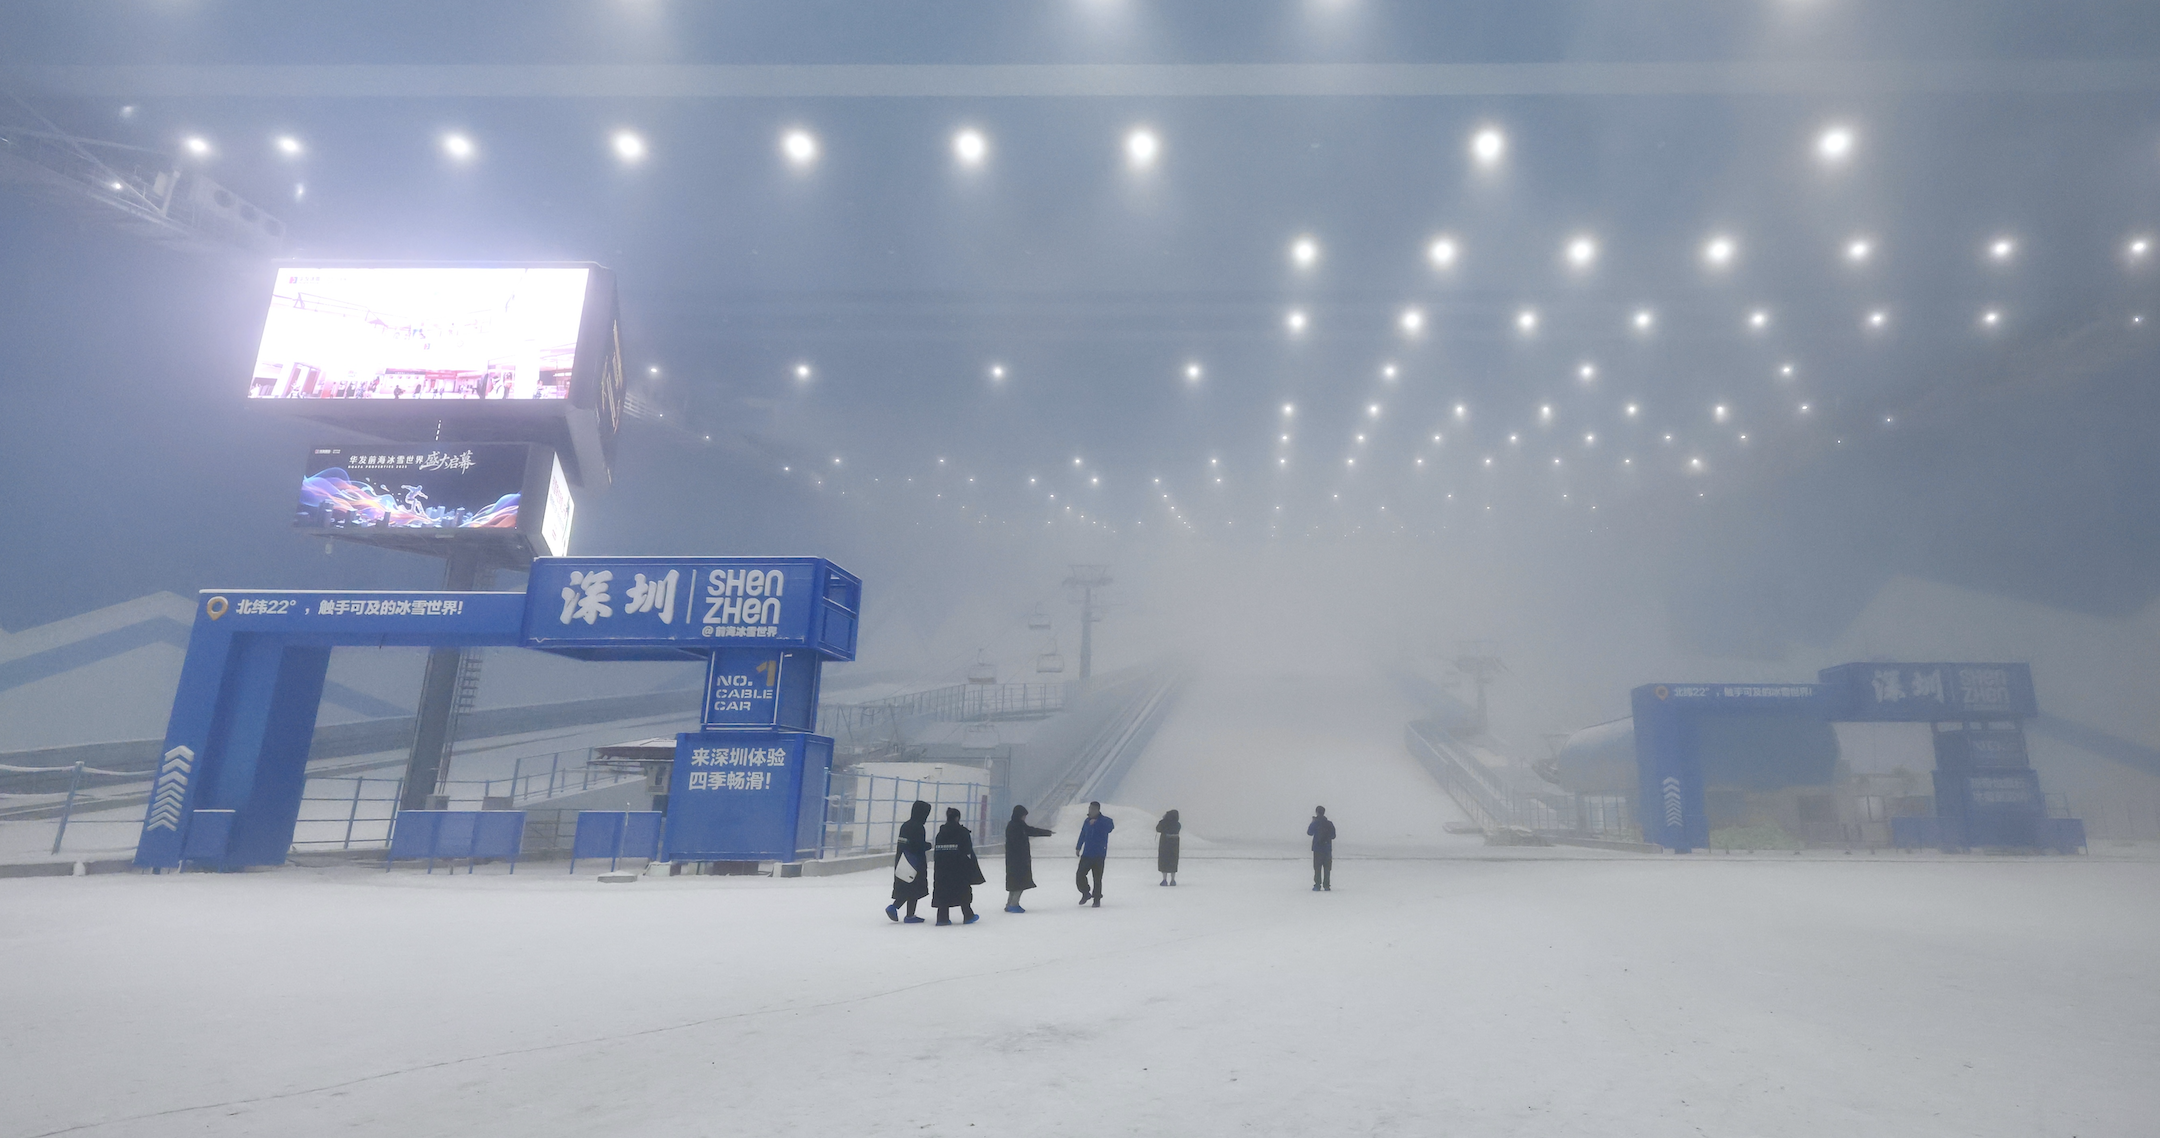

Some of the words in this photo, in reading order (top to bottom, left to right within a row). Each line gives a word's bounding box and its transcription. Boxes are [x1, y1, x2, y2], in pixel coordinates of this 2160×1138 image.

[348, 455, 424, 465] 华发前海冰雪世界
[560, 569, 680, 625] 深圳
[717, 675, 753, 687] NO.
[756, 660, 777, 687] 1
[715, 689, 774, 699] CABLE
[714, 701, 752, 711] CAR
[691, 747, 787, 767] 来深圳体验
